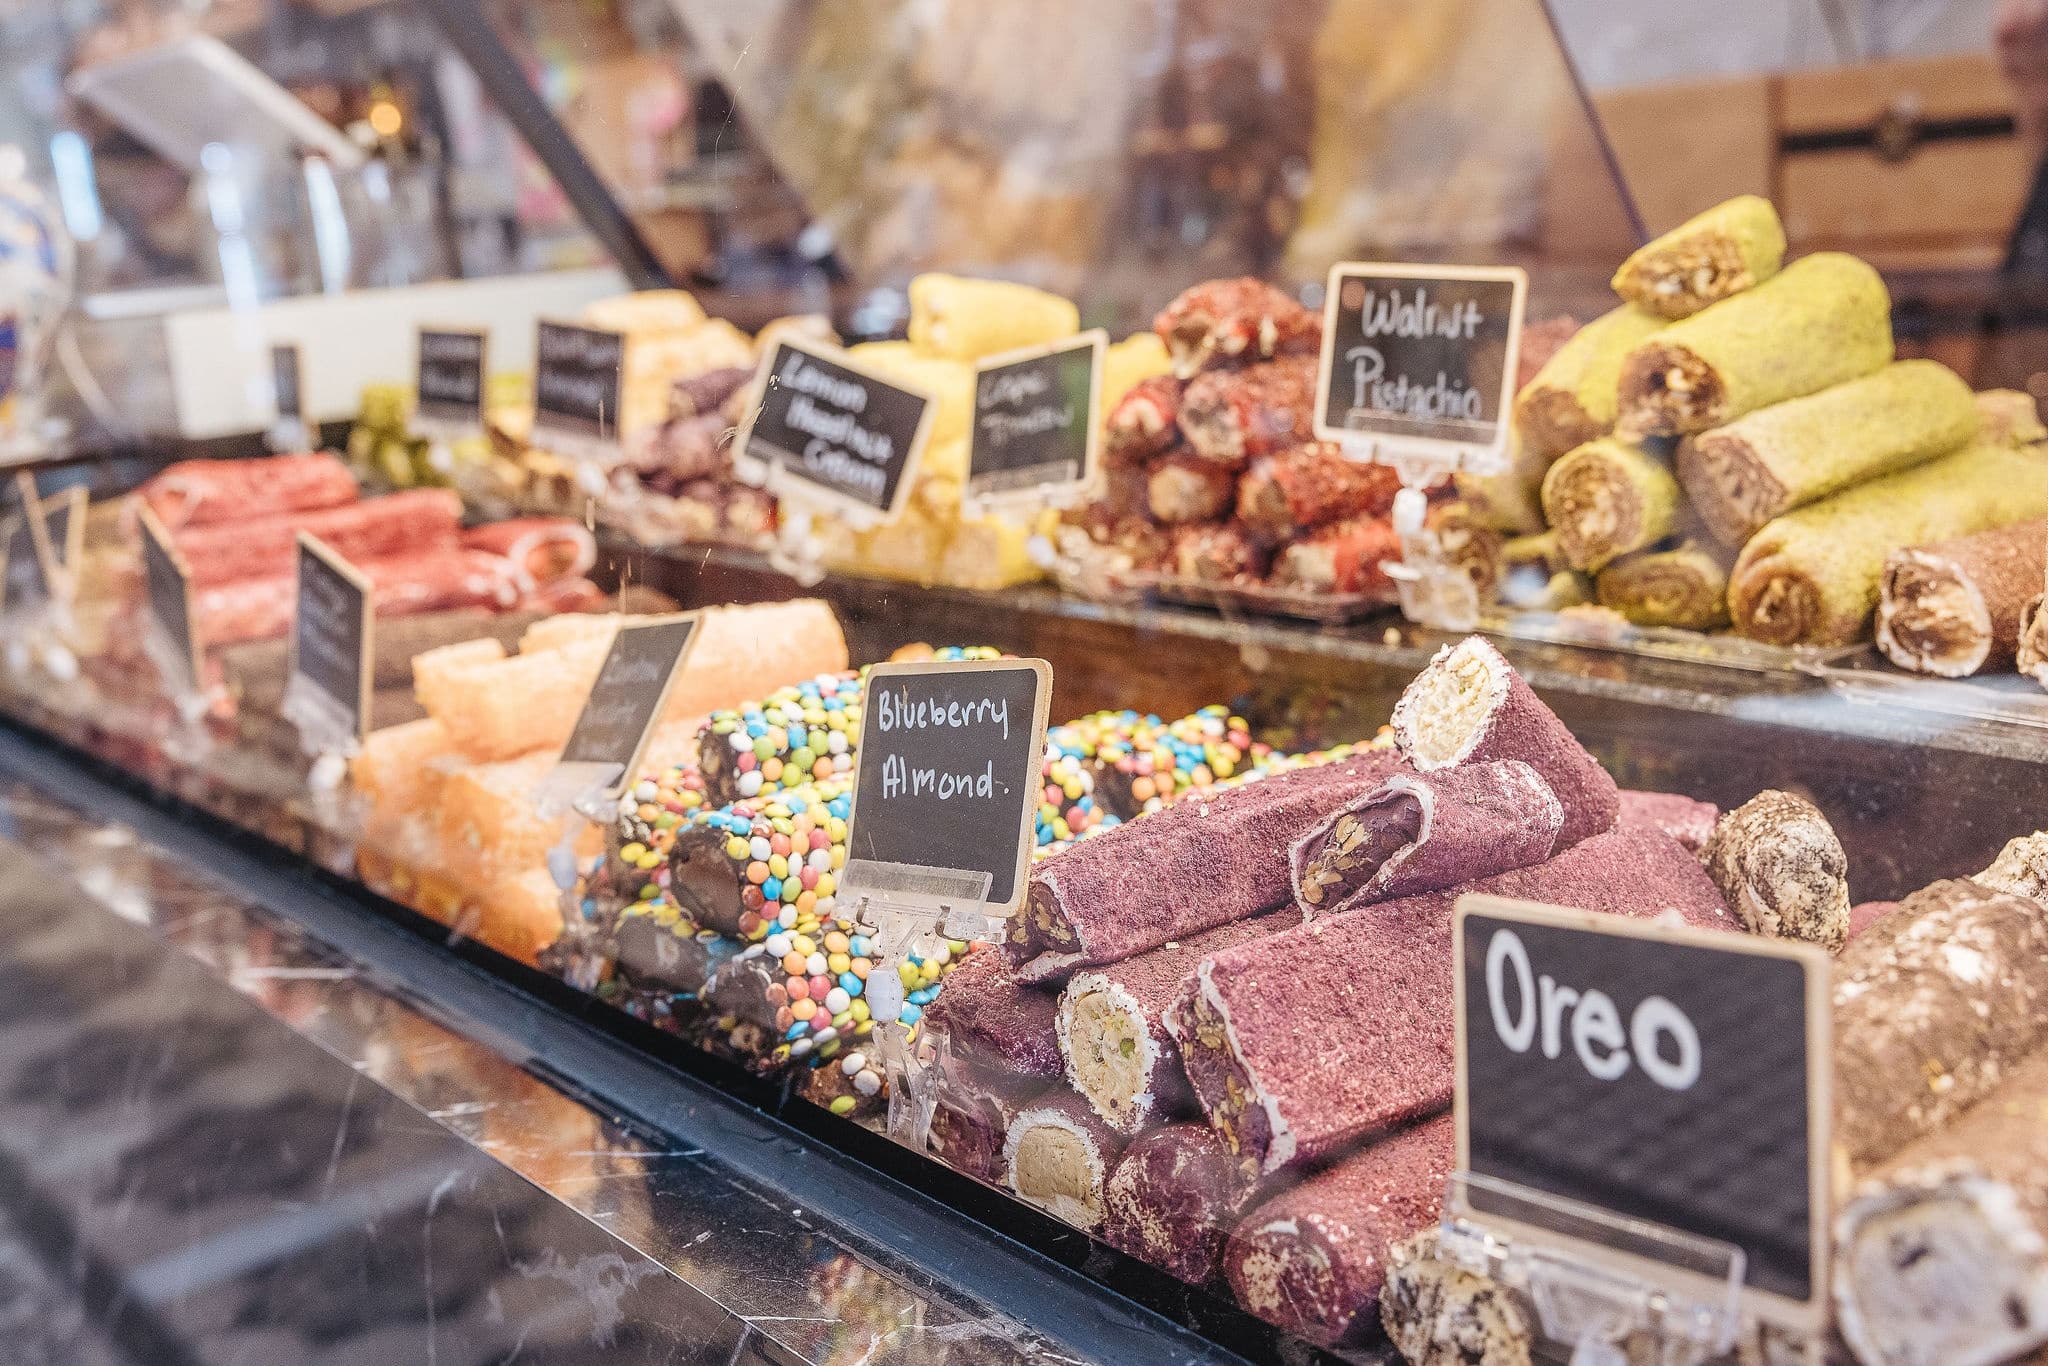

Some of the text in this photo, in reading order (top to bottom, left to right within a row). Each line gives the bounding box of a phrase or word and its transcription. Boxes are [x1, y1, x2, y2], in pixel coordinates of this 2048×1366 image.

[1361, 286, 1484, 339] Walnut
[780, 350, 868, 413] Lemon
[1344, 345, 1482, 421] Pistachio
[879, 689, 1009, 741] Blueberry
[1485, 928, 1701, 1090] Oreo
